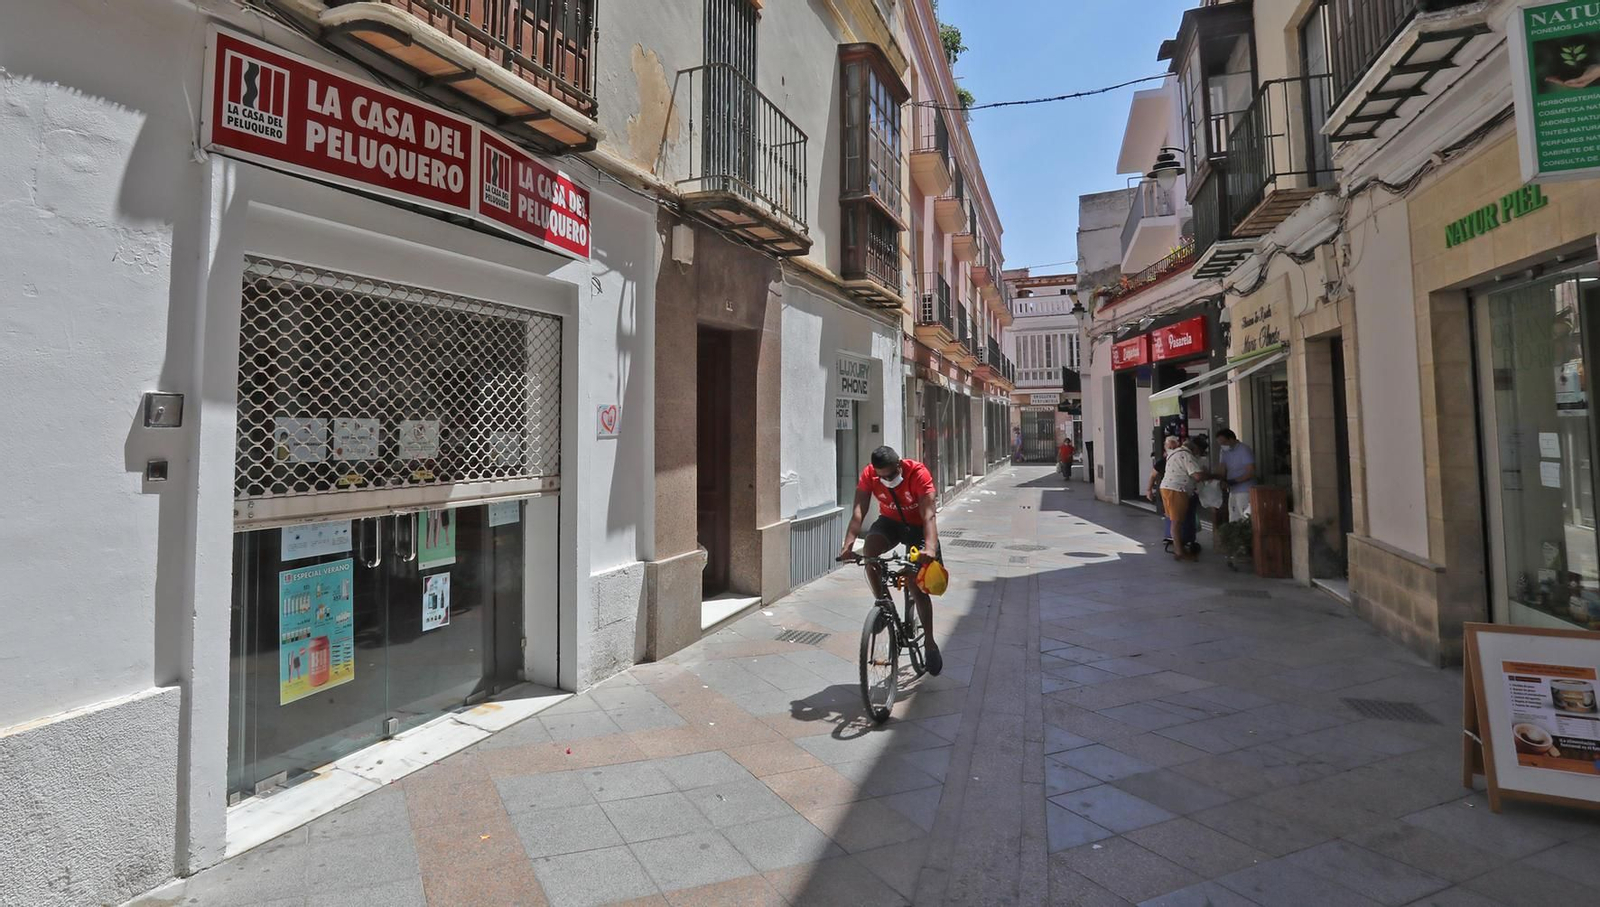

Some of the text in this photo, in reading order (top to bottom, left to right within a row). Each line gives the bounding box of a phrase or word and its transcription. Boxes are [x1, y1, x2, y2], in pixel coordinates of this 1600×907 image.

[1531, 24, 1572, 36] PONEMOS
[1573, 21, 1584, 29] LA
[228, 104, 283, 128] LA CASA DEL
[307, 78, 464, 160] LA CASA DEL
[1538, 105, 1585, 117] COSMÉTICA
[227, 115, 283, 139] PELUQUERO
[1539, 114, 1600, 128] JABONES NATU
[1541, 128, 1568, 137] TINTES
[1541, 136, 1584, 147] PERFUMES
[305, 120, 464, 193] PELUQUERO
[1542, 147, 1581, 157] GABINETE
[1543, 157, 1586, 167] CONSULTA
[485, 183, 491, 193] LA
[491, 186, 502, 198] CASA
[518, 162, 587, 220] LA CASA DEL
[485, 192, 509, 209] PELUQUERO
[518, 193, 587, 246] PELUQUERO
[1444, 184, 1548, 249] NATUR PIEL
[1168, 332, 1193, 350] Pasarela
[839, 358, 870, 379] LUXURY
[842, 378, 868, 395] PHONE
[836, 409, 849, 418] HONE
[293, 563, 350, 581] ESPECIAL VERANO
